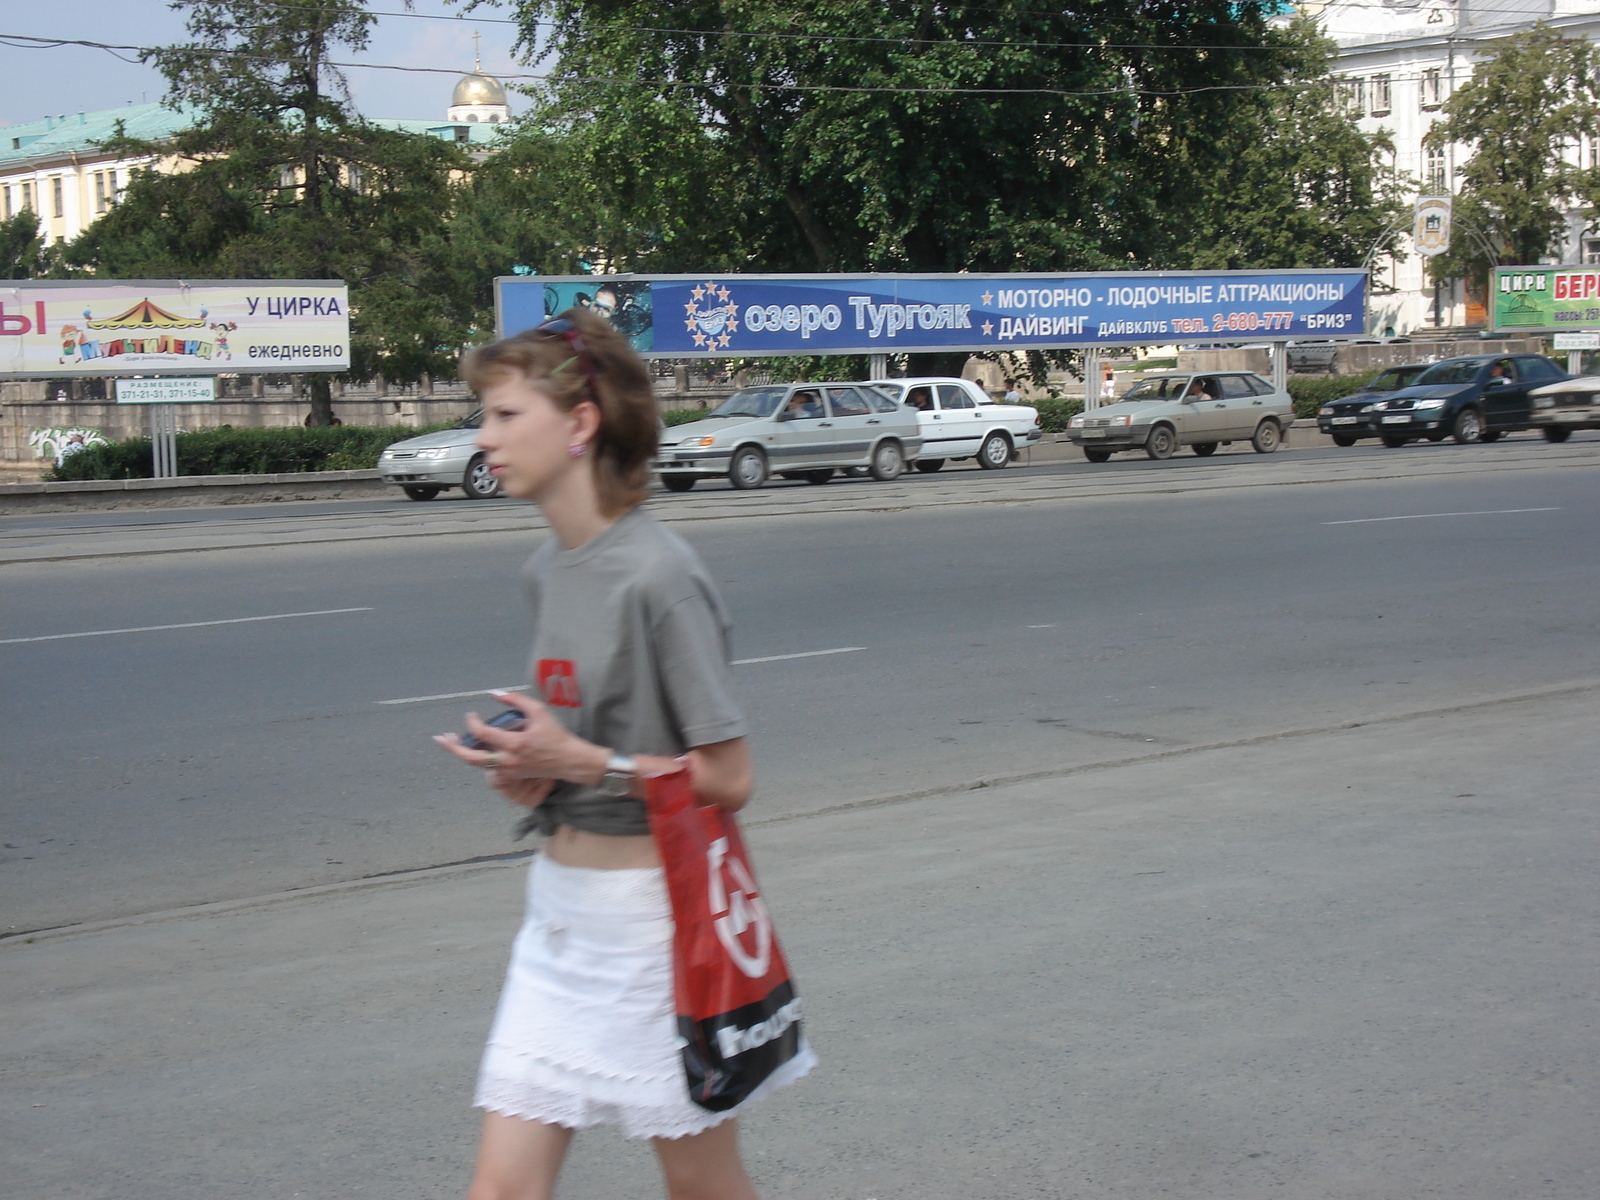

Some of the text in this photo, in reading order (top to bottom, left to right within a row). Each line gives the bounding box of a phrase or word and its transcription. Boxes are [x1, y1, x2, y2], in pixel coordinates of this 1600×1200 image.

[1501, 274, 1546, 293] ЦИРК
[1554, 273, 1600, 300] БЕР
[246, 296, 342, 319] У ЦИРКА
[998, 287, 1092, 309] МОТОРНО
[1106, 285, 1213, 309] ЛОДОЧНЫЕ
[1216, 283, 1344, 304] АТТРАКЦИОНЫ
[744, 296, 972, 339] озеро Тургояк
[998, 313, 1089, 341] ДАЙВИНГ
[1097, 319, 1168, 338] ДАЙВКЛУБ
[1171, 317, 1210, 334] тел.
[1212, 311, 1295, 333] 2-680-777
[248, 344, 343, 361] ежедневно
[121, 388, 211, 400] 371-21-31, 371-15-40
[130, 380, 203, 388] РАЗМЕЩЕНИЕ:
